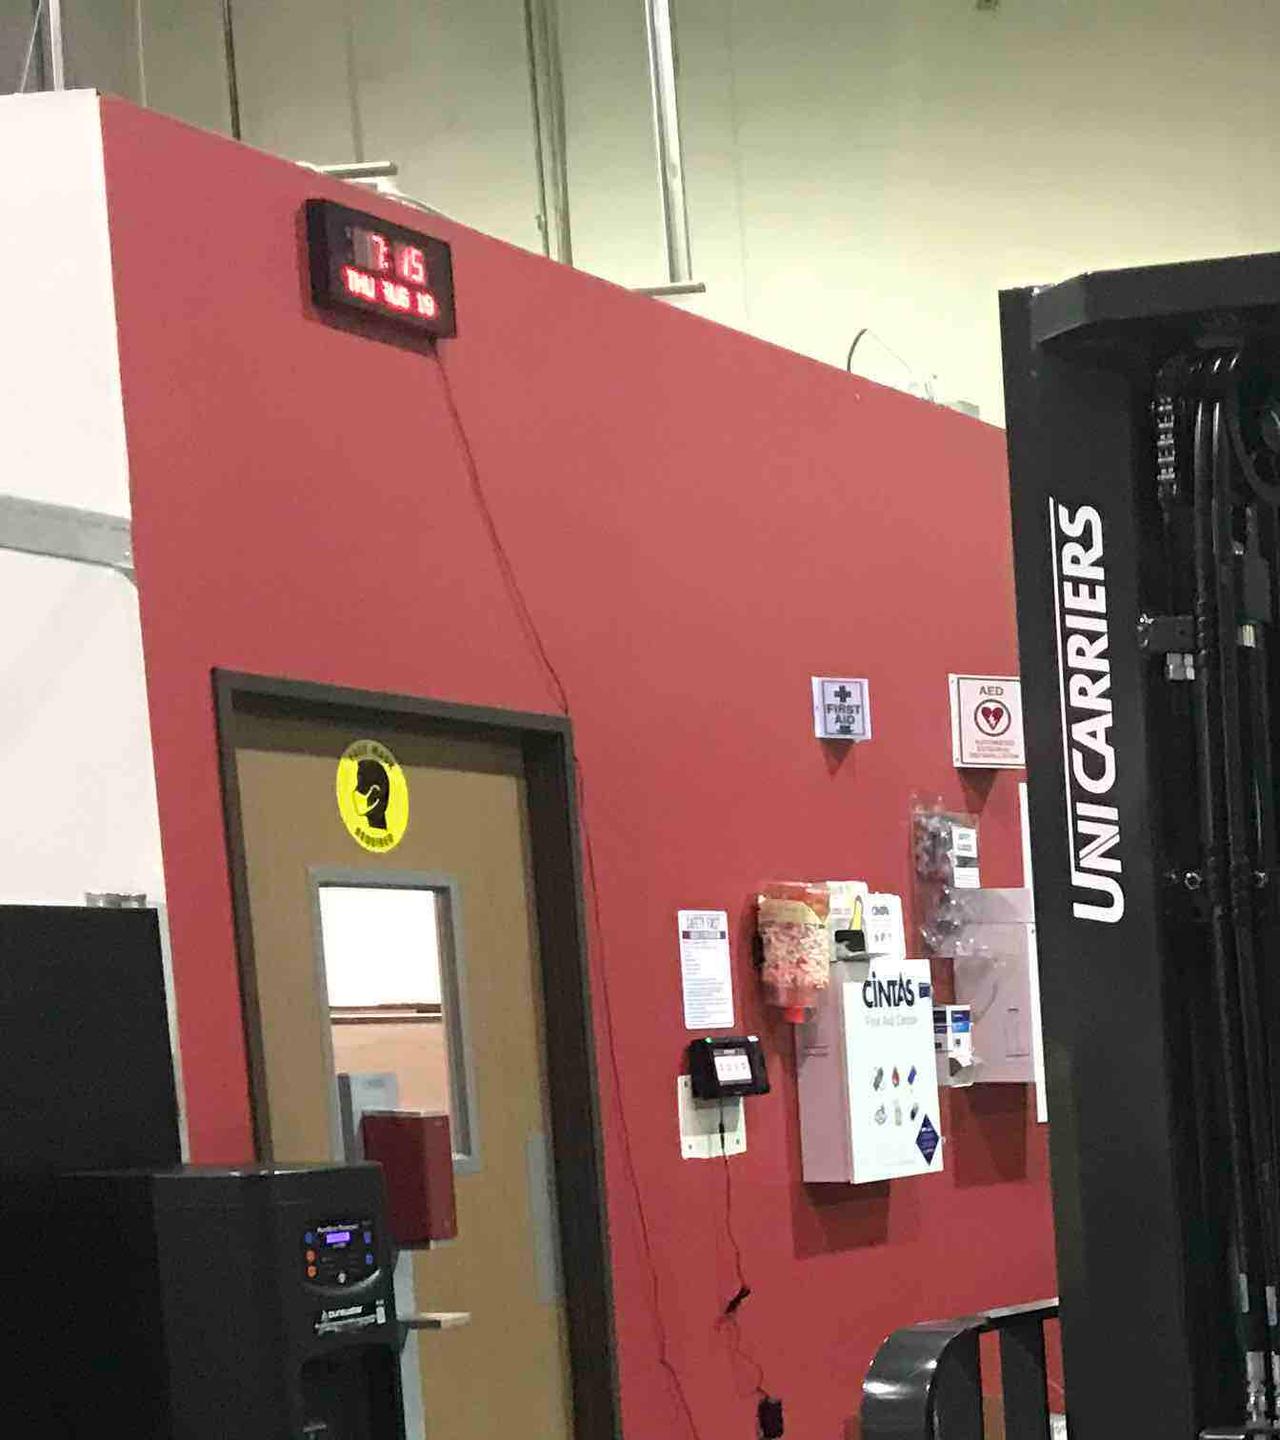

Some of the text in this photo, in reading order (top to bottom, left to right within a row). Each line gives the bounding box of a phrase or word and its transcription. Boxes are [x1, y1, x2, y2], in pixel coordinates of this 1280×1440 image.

[979, 686, 1004, 696] AED
[827, 703, 860, 714] FIRST
[835, 715, 855, 724] AID
[862, 971, 915, 1009] CINTAS
